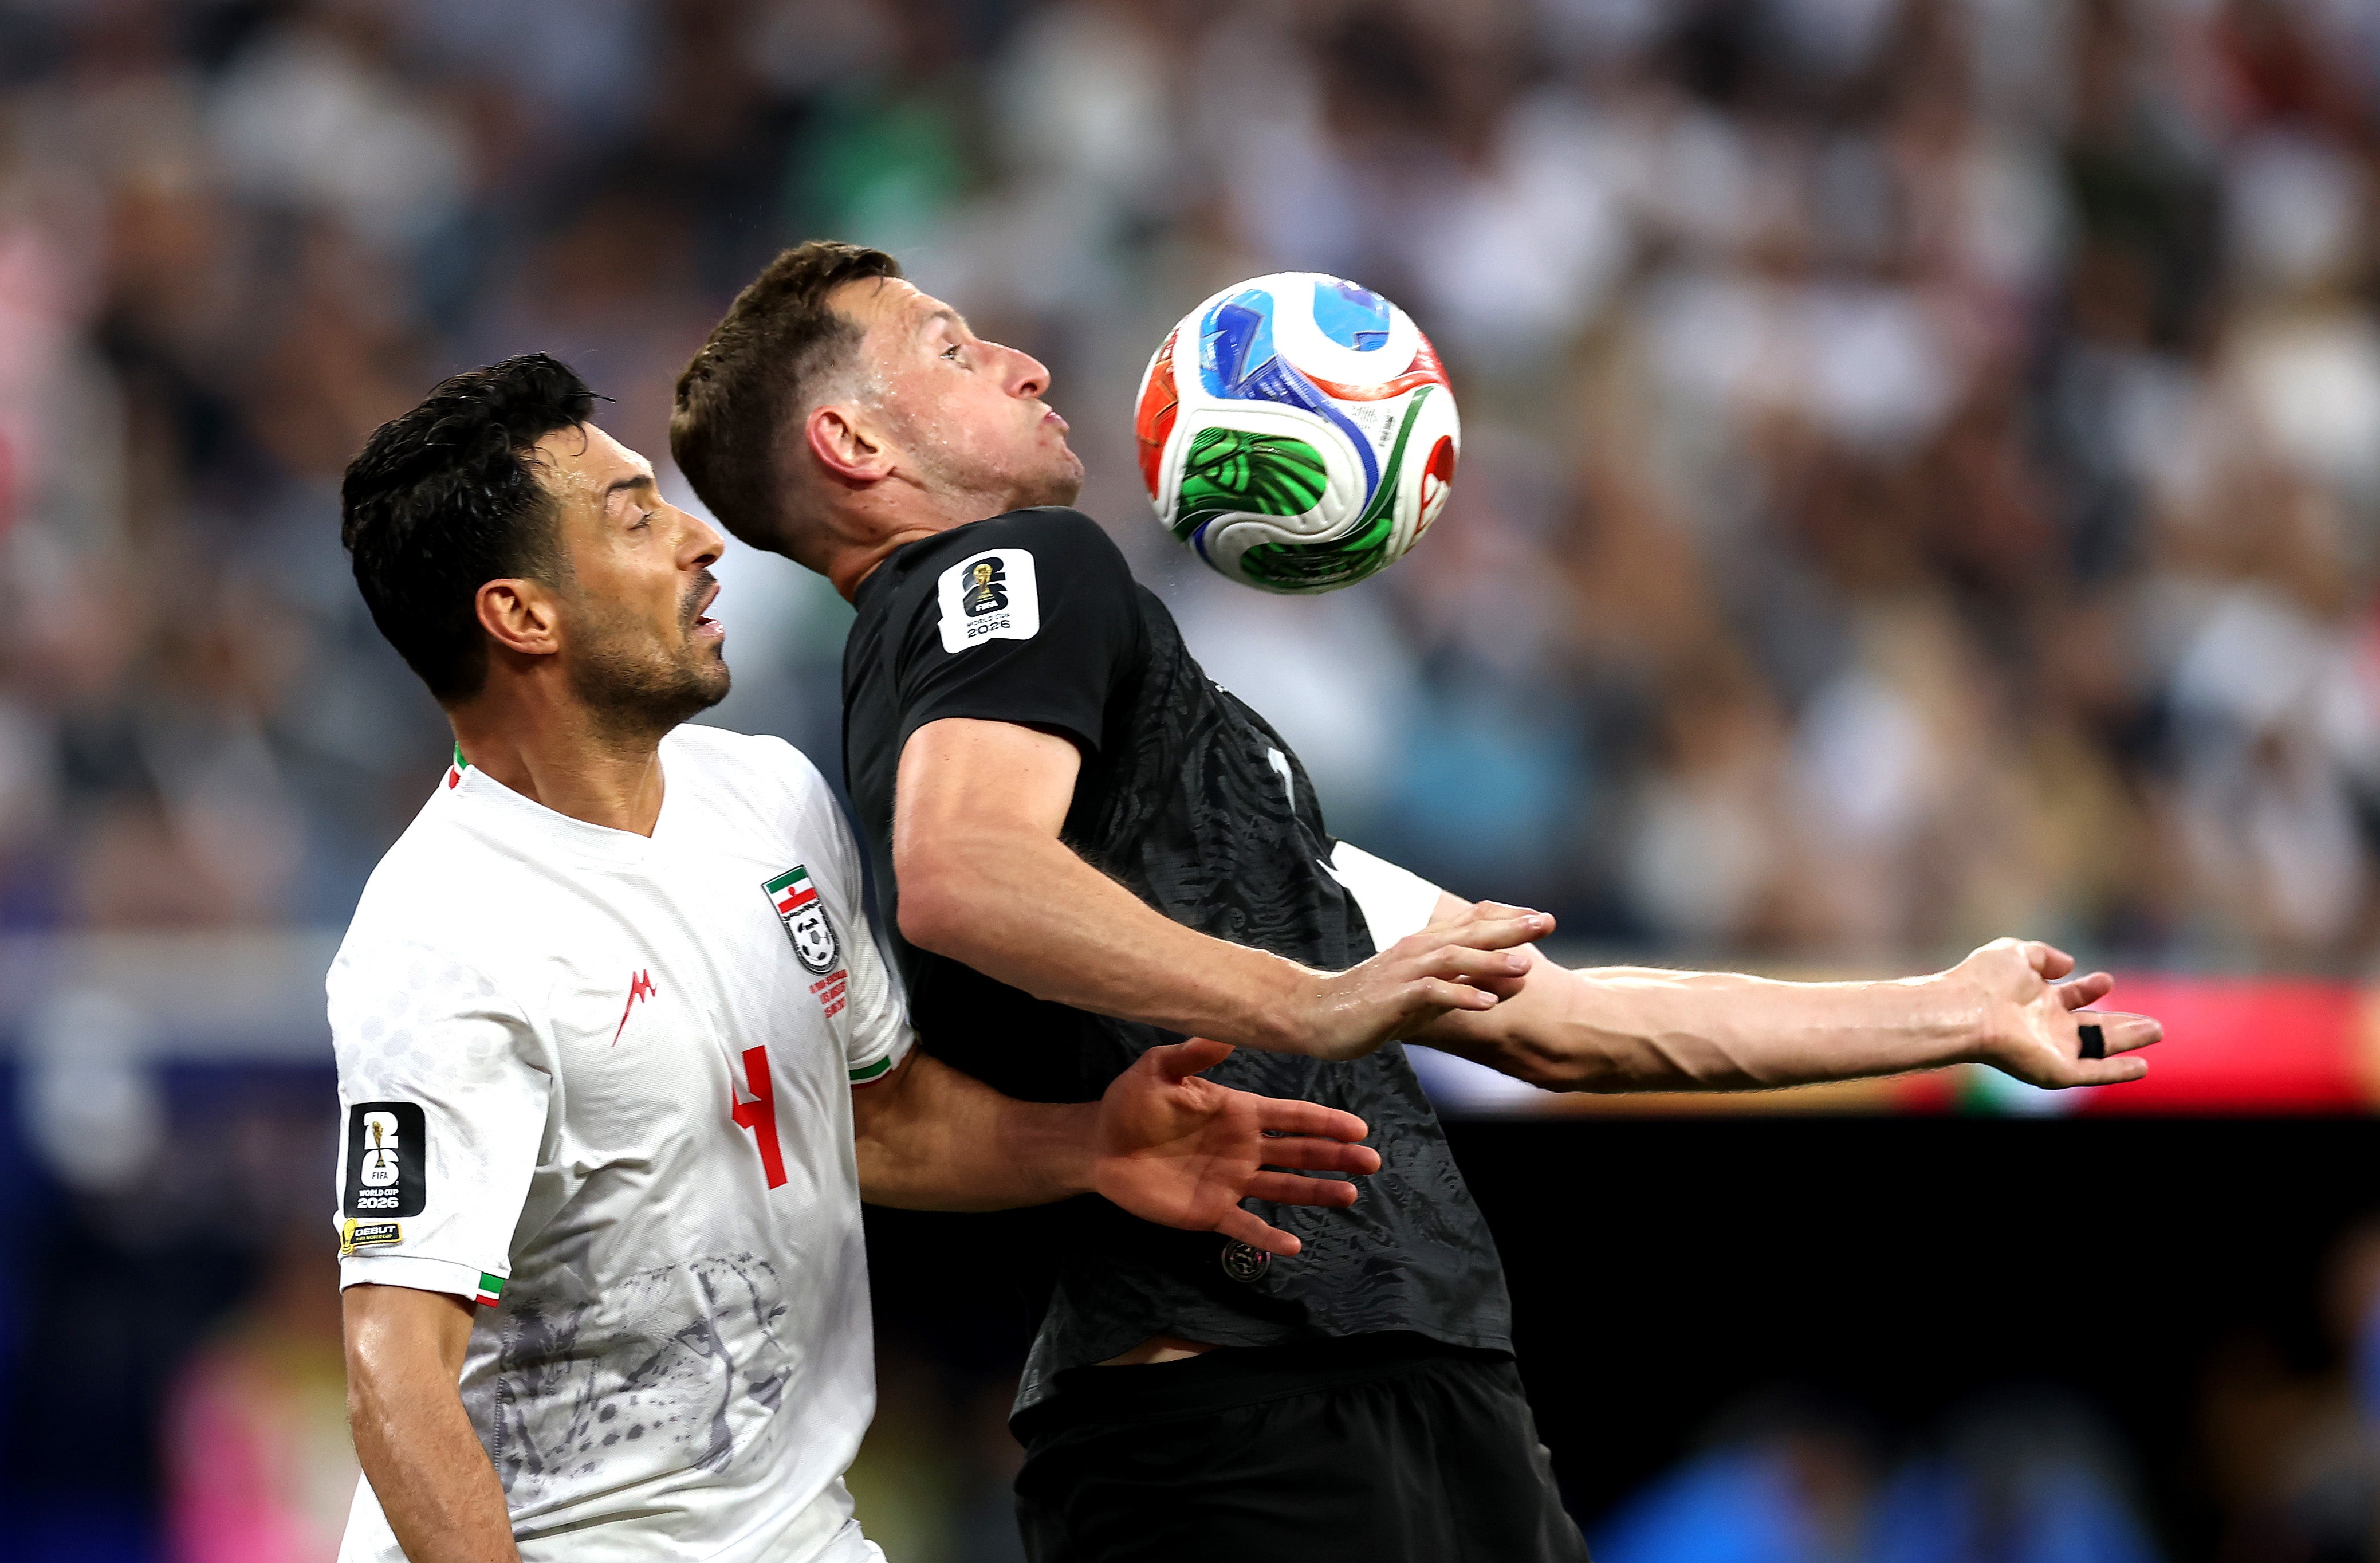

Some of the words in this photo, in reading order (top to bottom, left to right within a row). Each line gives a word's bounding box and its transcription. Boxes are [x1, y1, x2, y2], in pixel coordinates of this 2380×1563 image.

[967, 616, 993, 627] WORLD
[967, 620, 1010, 638] 2026
[731, 1044, 788, 1190] 4
[372, 1171, 388, 1180] FIFA
[359, 1189, 384, 1197] WORLD
[357, 1197, 399, 1209] 2026
[355, 1226, 396, 1236] DEBUT
